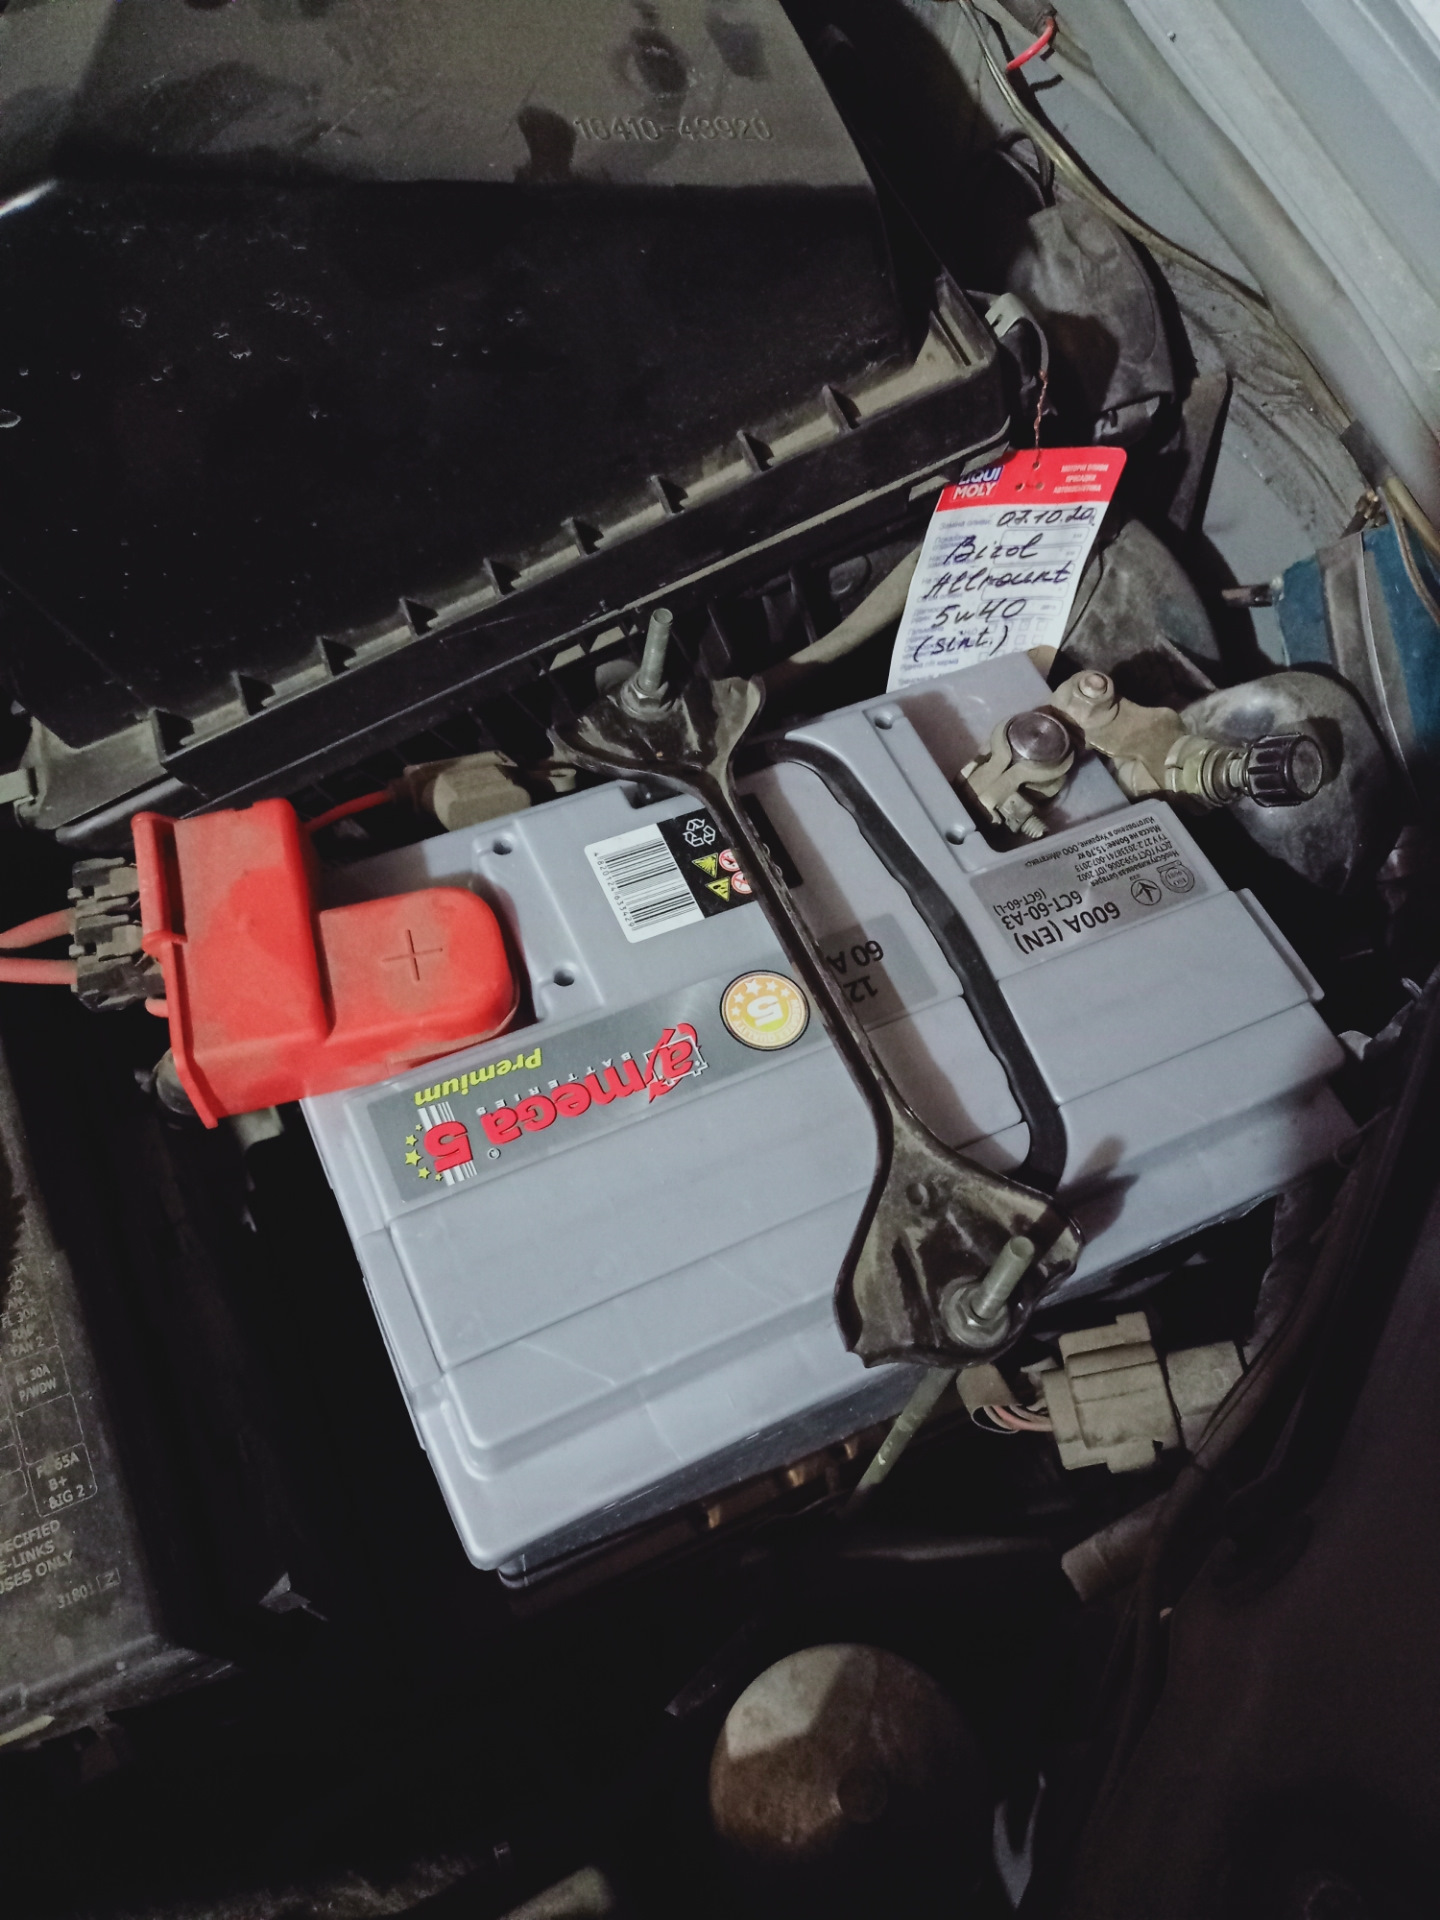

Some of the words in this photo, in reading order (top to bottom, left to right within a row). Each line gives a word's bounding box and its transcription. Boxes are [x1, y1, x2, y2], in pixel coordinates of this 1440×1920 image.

[953, 482, 998, 500] MOLY
[1104, 836, 1129, 850] более:
[1138, 825, 1160, 838] Масса
[1061, 899, 1121, 936] 600A
[1012, 919, 1063, 955] (EN)
[852, 940, 884, 967] 60
[747, 995, 783, 1027] 5
[415, 1048, 542, 1106] Premium
[476, 1052, 633, 1116] BATTERIES
[423, 1120, 474, 1173] 5
[29, 1363, 51, 1381] 30A
[76, 1483, 86, 1498] 2
[35, 1549, 74, 1577] ONLY
